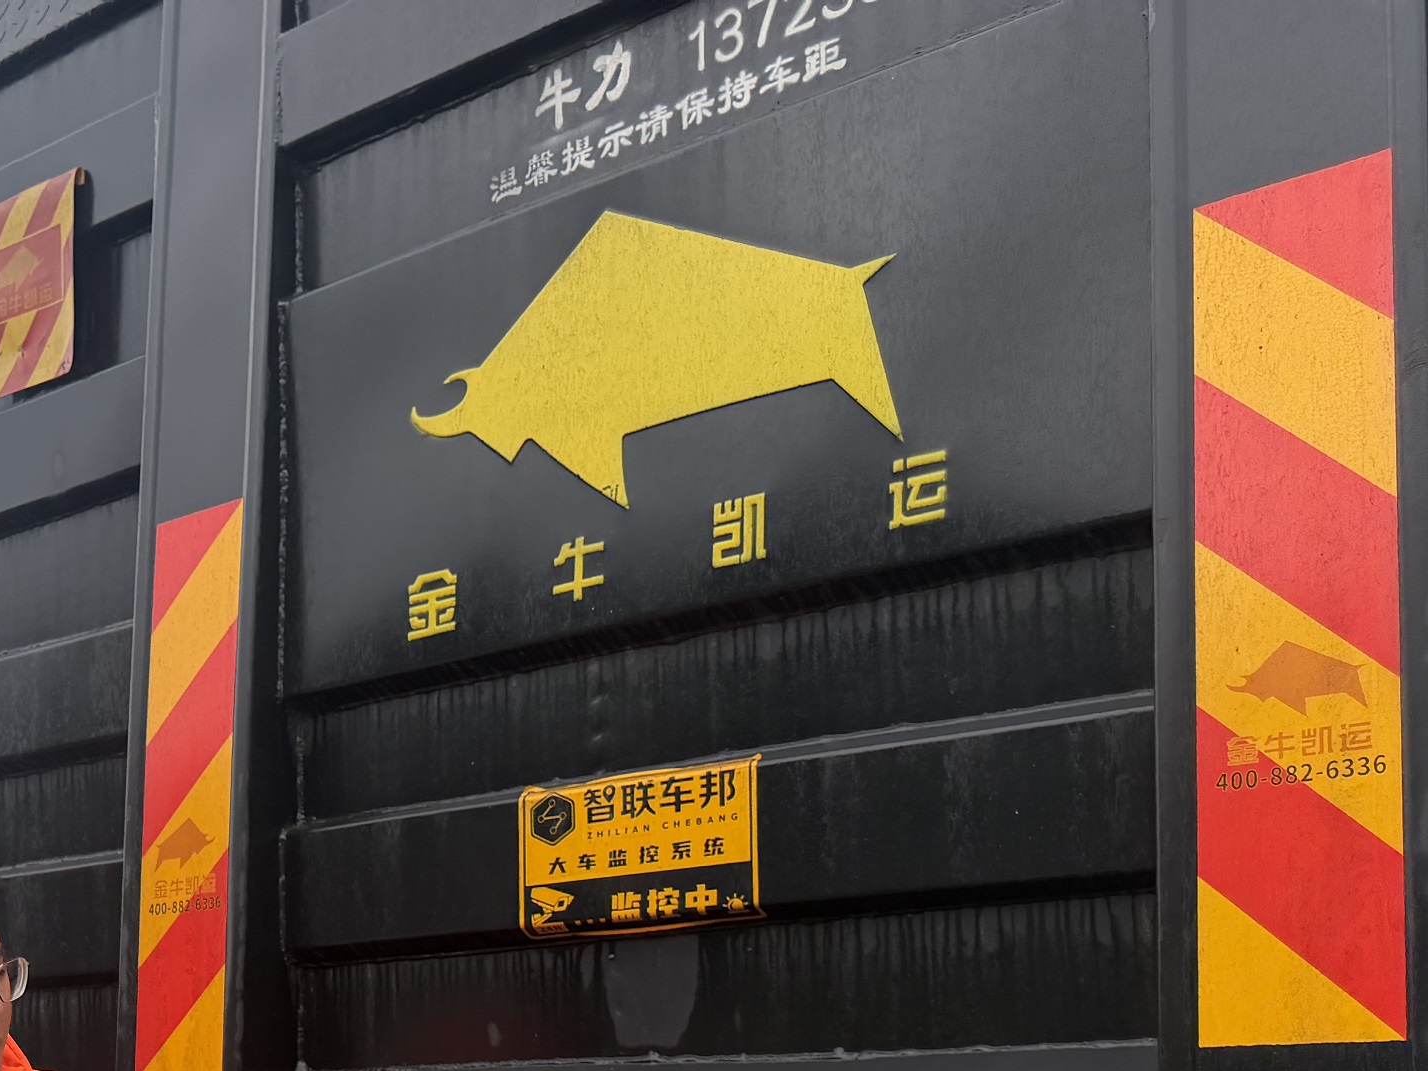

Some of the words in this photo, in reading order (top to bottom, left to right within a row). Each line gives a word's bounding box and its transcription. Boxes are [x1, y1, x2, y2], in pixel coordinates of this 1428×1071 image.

[535, 41, 632, 130] 牛力
[489, 37, 847, 203] 温馨提示请保持车距
[407, 449, 947, 642] 金牛凯运
[1227, 720, 1373, 767] 金牛凯运
[1216, 754, 1387, 792] 400-882-6336
[583, 768, 736, 825] 智联车邦
[587, 824, 651, 840] ZHILIAN
[662, 812, 740, 830] CHEBANG
[548, 837, 725, 875] 大车监控系统
[154, 872, 217, 899] 金牛凯运
[611, 883, 718, 923] 监控中
[148, 896, 221, 916] 400-882-6336
